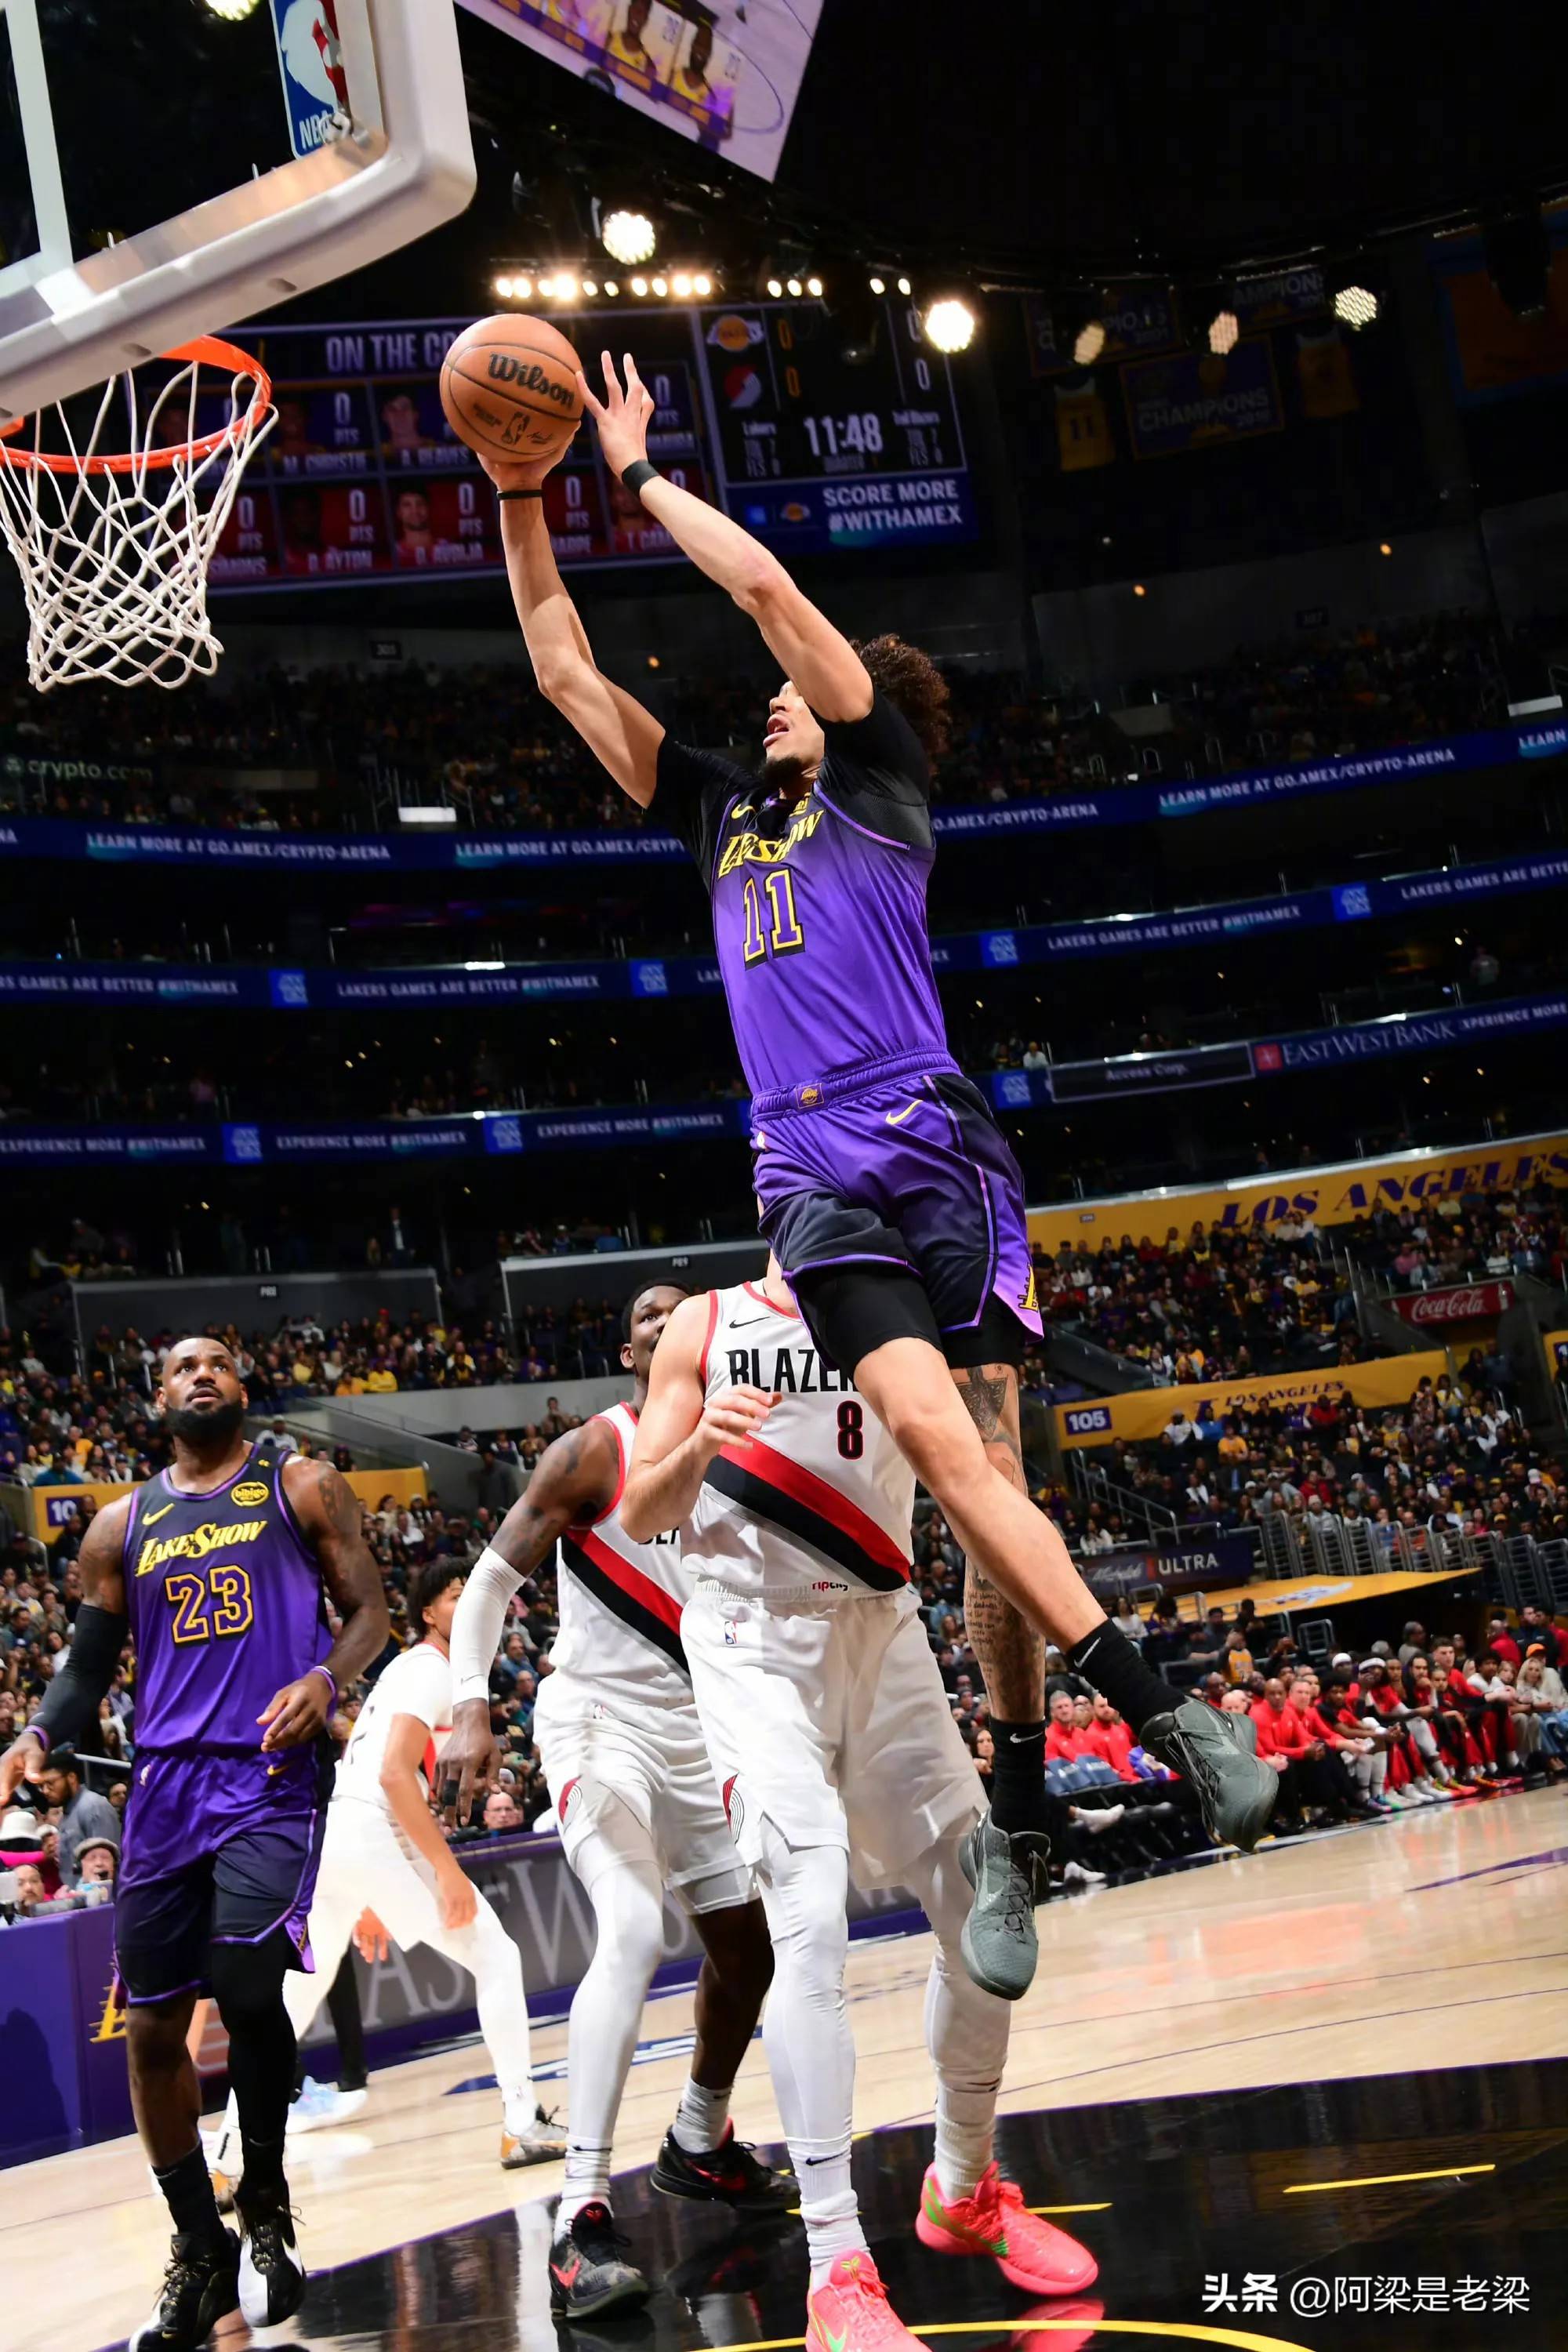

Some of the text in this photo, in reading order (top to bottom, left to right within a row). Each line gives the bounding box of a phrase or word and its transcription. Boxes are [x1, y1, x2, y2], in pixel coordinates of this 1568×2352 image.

[326, 336, 365, 372] ON
[370, 333, 417, 370] THE
[488, 351, 575, 412] Wilson
[803, 412, 884, 456] 11:48
[823, 479, 959, 507] SCORE MORE
[829, 506, 963, 533] #WITHAMEX
[1159, 788, 1207, 808] LEARN
[1210, 779, 1251, 800] MORE
[1254, 777, 1272, 793] AT
[87, 832, 137, 850] LEARN
[140, 835, 183, 853] MORE
[187, 837, 204, 854] AT
[455, 842, 503, 857] LEARN
[506, 841, 548, 857] MORE
[550, 840, 568, 855] AT
[743, 869, 805, 970] 11
[1218, 1189, 1319, 1229] LOS
[725, 1347, 858, 1393] BLAZE
[837, 1399, 864, 1460] 8
[1069, 1410, 1107, 1432] 105
[1158, 1552, 1219, 1576] ULTRA
[165, 1565, 253, 1644] 23
